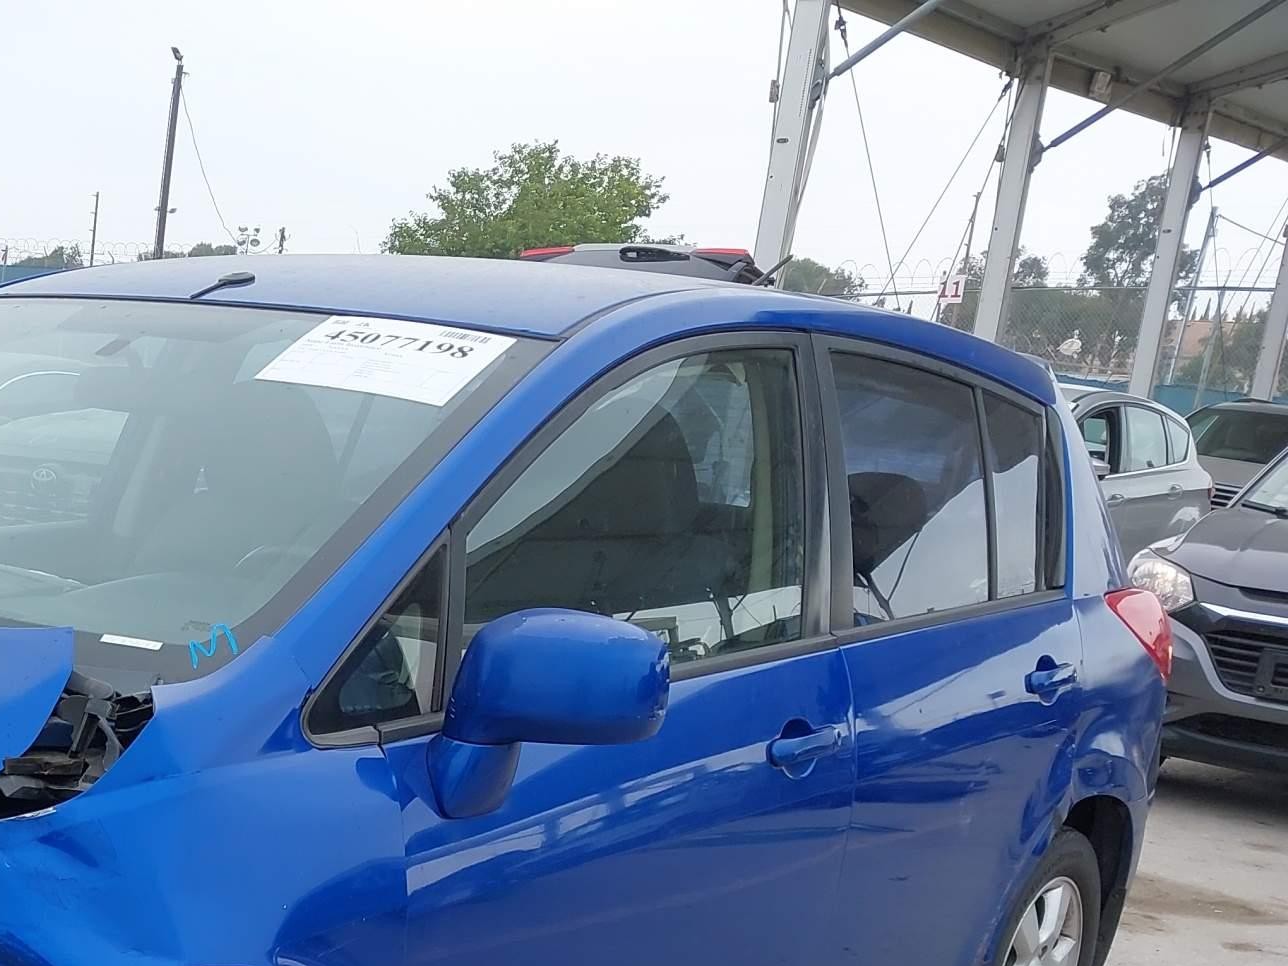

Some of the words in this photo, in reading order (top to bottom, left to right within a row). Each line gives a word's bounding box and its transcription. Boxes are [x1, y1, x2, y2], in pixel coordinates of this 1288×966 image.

[939, 281, 960, 298] 11
[325, 330, 474, 358] 45077198
[189, 624, 238, 669] M
